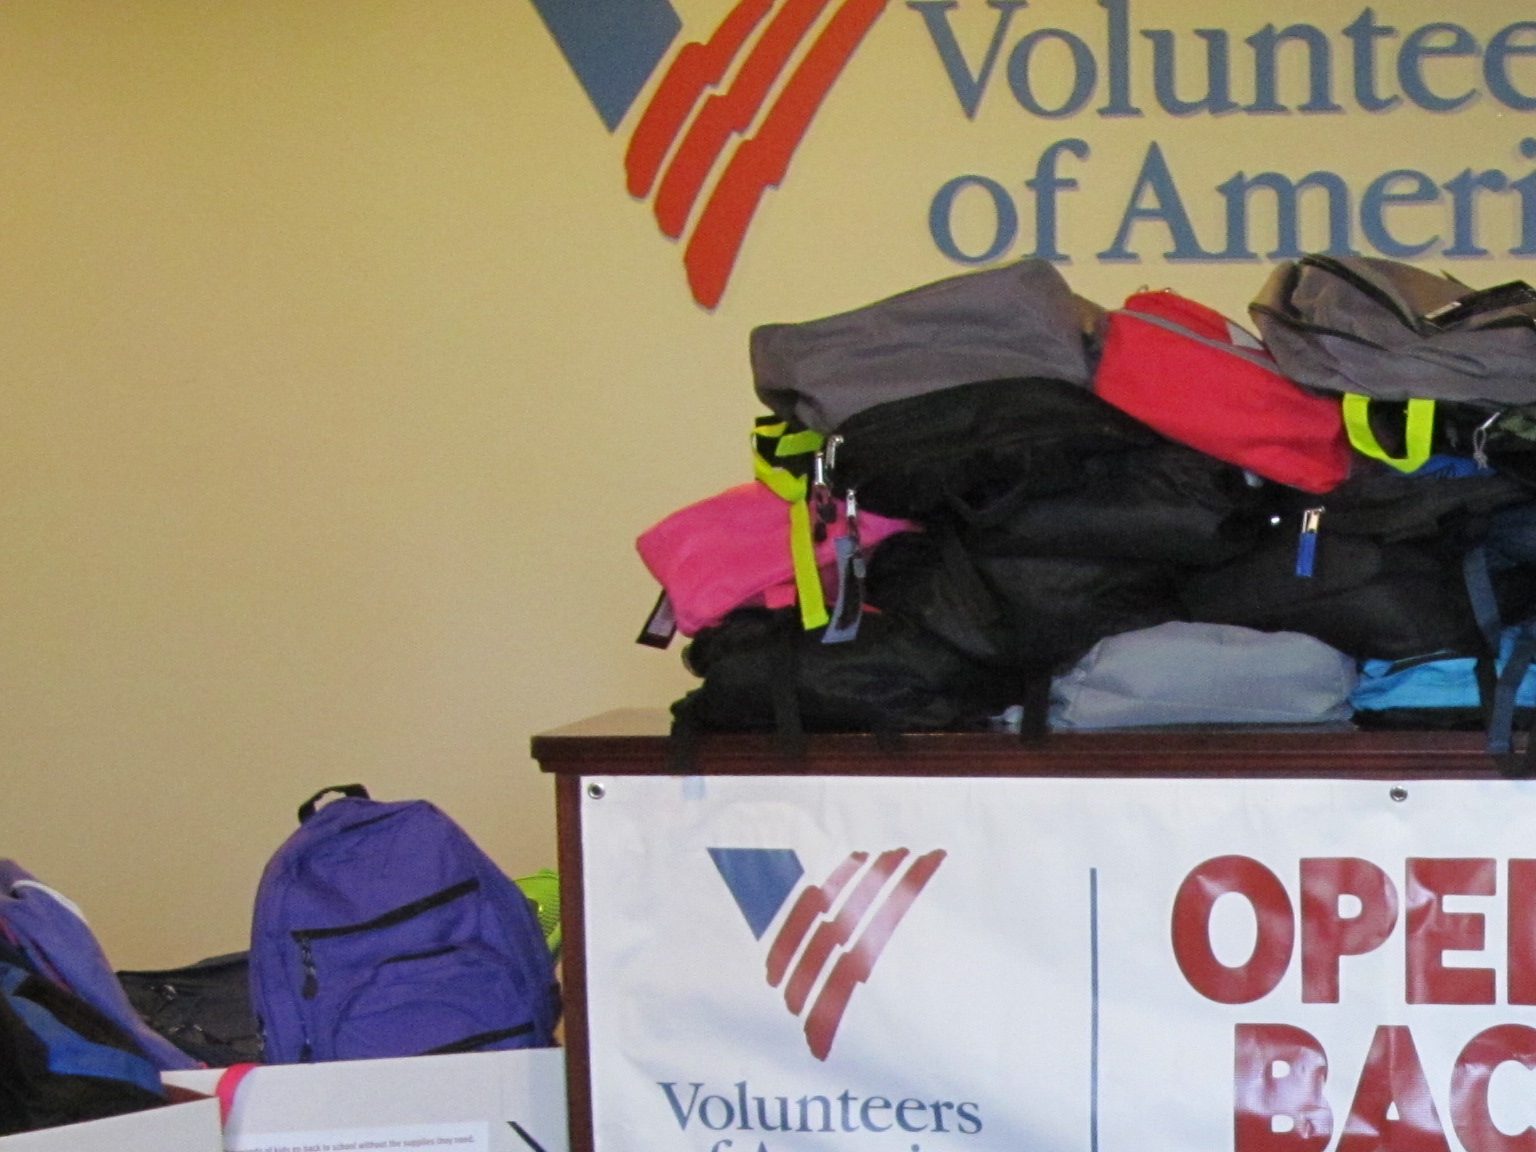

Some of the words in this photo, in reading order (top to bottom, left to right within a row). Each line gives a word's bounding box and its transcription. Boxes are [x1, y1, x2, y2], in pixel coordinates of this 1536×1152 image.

[929, 138, 1090, 263] of
[657, 1081, 983, 1135] Volunteers
[332, 1141, 357, 1151] school
